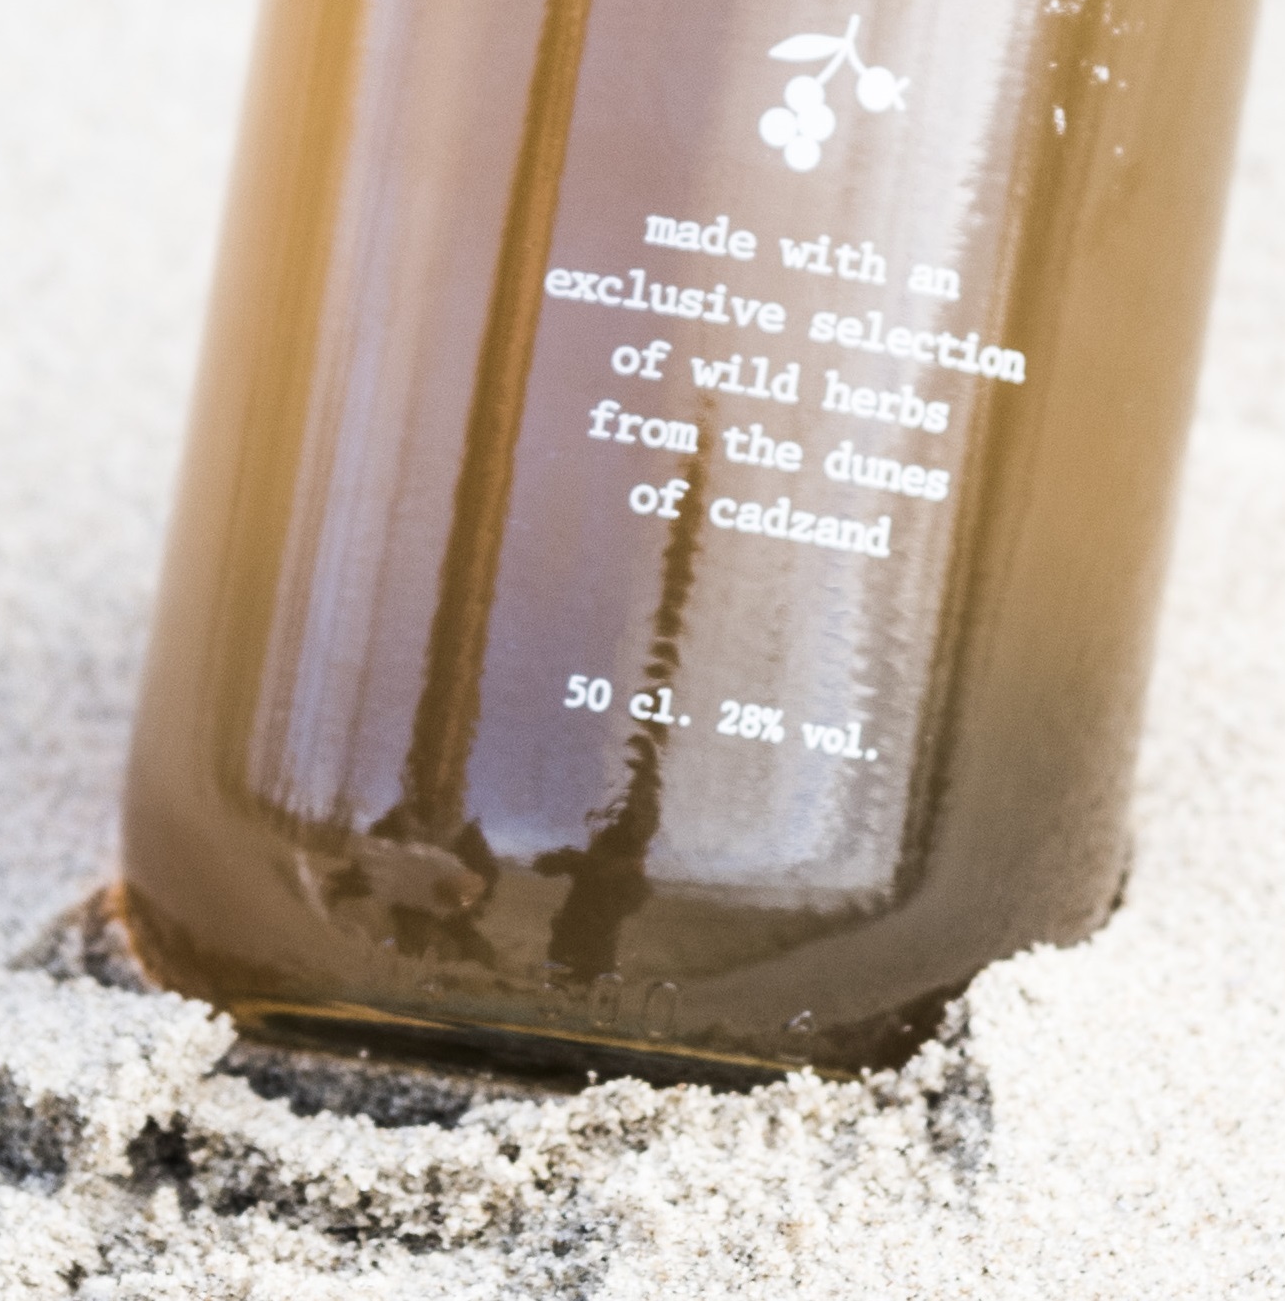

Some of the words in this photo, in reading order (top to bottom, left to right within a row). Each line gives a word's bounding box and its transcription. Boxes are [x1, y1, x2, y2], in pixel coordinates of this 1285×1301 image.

[643, 215, 756, 261] made
[779, 235, 886, 284] with
[907, 262, 960, 300] an
[545, 268, 786, 334] exclusive
[809, 310, 1025, 383] selection
[611, 340, 672, 379] of
[691, 355, 800, 403] wild
[822, 370, 950, 433] herbs
[587, 400, 699, 453] from
[723, 424, 802, 471] the
[824, 441, 950, 501] dunes
[629, 479, 689, 518] of
[709, 497, 891, 558] cadzand
[563, 674, 612, 713] 50
[629, 688, 691, 728] cl.
[716, 700, 785, 744] 28%
[801, 722, 878, 761] vol.
